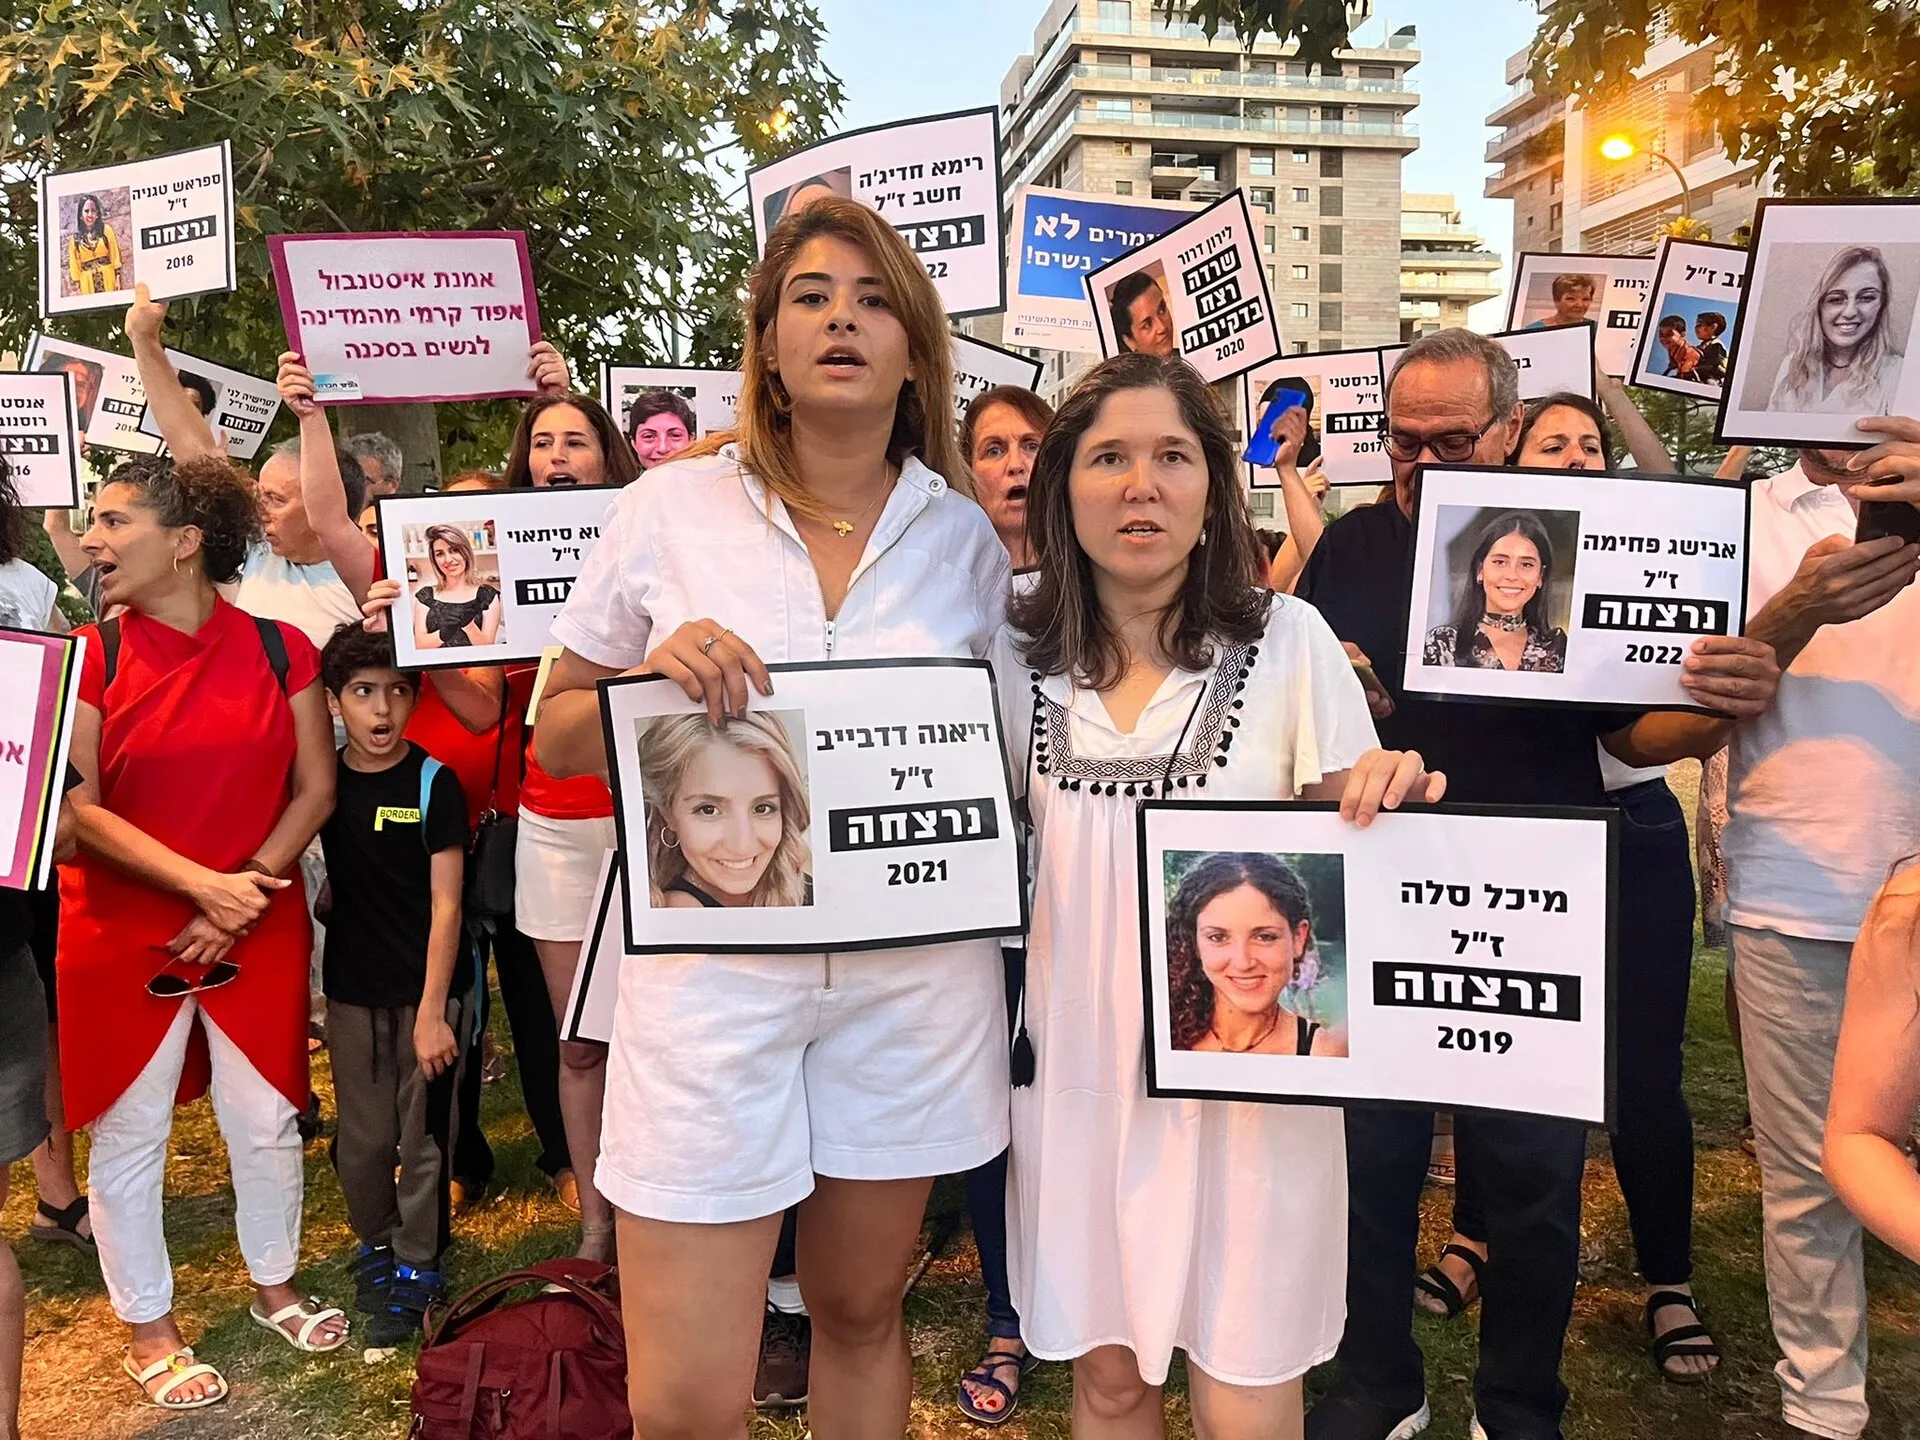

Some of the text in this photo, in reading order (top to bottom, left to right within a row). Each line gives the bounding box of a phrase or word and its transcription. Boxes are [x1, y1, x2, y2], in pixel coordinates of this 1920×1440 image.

[859, 156, 983, 189] רימא חדיג'ה
[132, 173, 221, 200] ספראש טגניה
[875, 186, 961, 211] חשב ז"ל
[168, 197, 187, 211] ז"ל
[148, 220, 209, 246] נרצחה
[1034, 213, 1081, 241] לא
[1027, 245, 1091, 270] נשים!
[1178, 225, 1233, 265] לירון דרור
[166, 254, 194, 270] 2018
[926, 262, 948, 279] 22
[1187, 249, 1237, 291] שרדה
[1685, 265, 1717, 284] ז"ל
[318, 269, 495, 290] אמנת איסטנבול
[1200, 282, 1237, 314] רצח
[301, 304, 524, 327] אפוד קרמי מהמדינה
[1184, 301, 1263, 351] בדקירות
[344, 335, 490, 360] לנשים בסכנה
[1215, 338, 1245, 361] 2020
[1329, 375, 1379, 388] כרסטני
[108, 400, 143, 417] צחה
[1356, 393, 1378, 404] ז"ל
[224, 416, 261, 432] נרצחה
[1334, 414, 1385, 431] צחה
[228, 437, 245, 445] 2021
[1352, 442, 1383, 453] 2017
[507, 527, 572, 543] סיתאוי
[1583, 534, 1736, 560] אבישג פחימה
[551, 547, 581, 561] ז"ל
[1643, 570, 1679, 589] ז"ל
[1598, 601, 1716, 630] נרצחה
[1624, 644, 1683, 665] 2022
[816, 723, 990, 751] דיאנה דדבייב
[890, 766, 933, 791] ז"ל
[848, 806, 982, 845] נרצחה
[887, 859, 948, 886] 2021
[1401, 879, 1568, 913] מיכל סלה
[1451, 929, 1504, 957] ז"ל
[1394, 970, 1558, 1012] נרצחה
[1437, 1025, 1513, 1054] 2019
